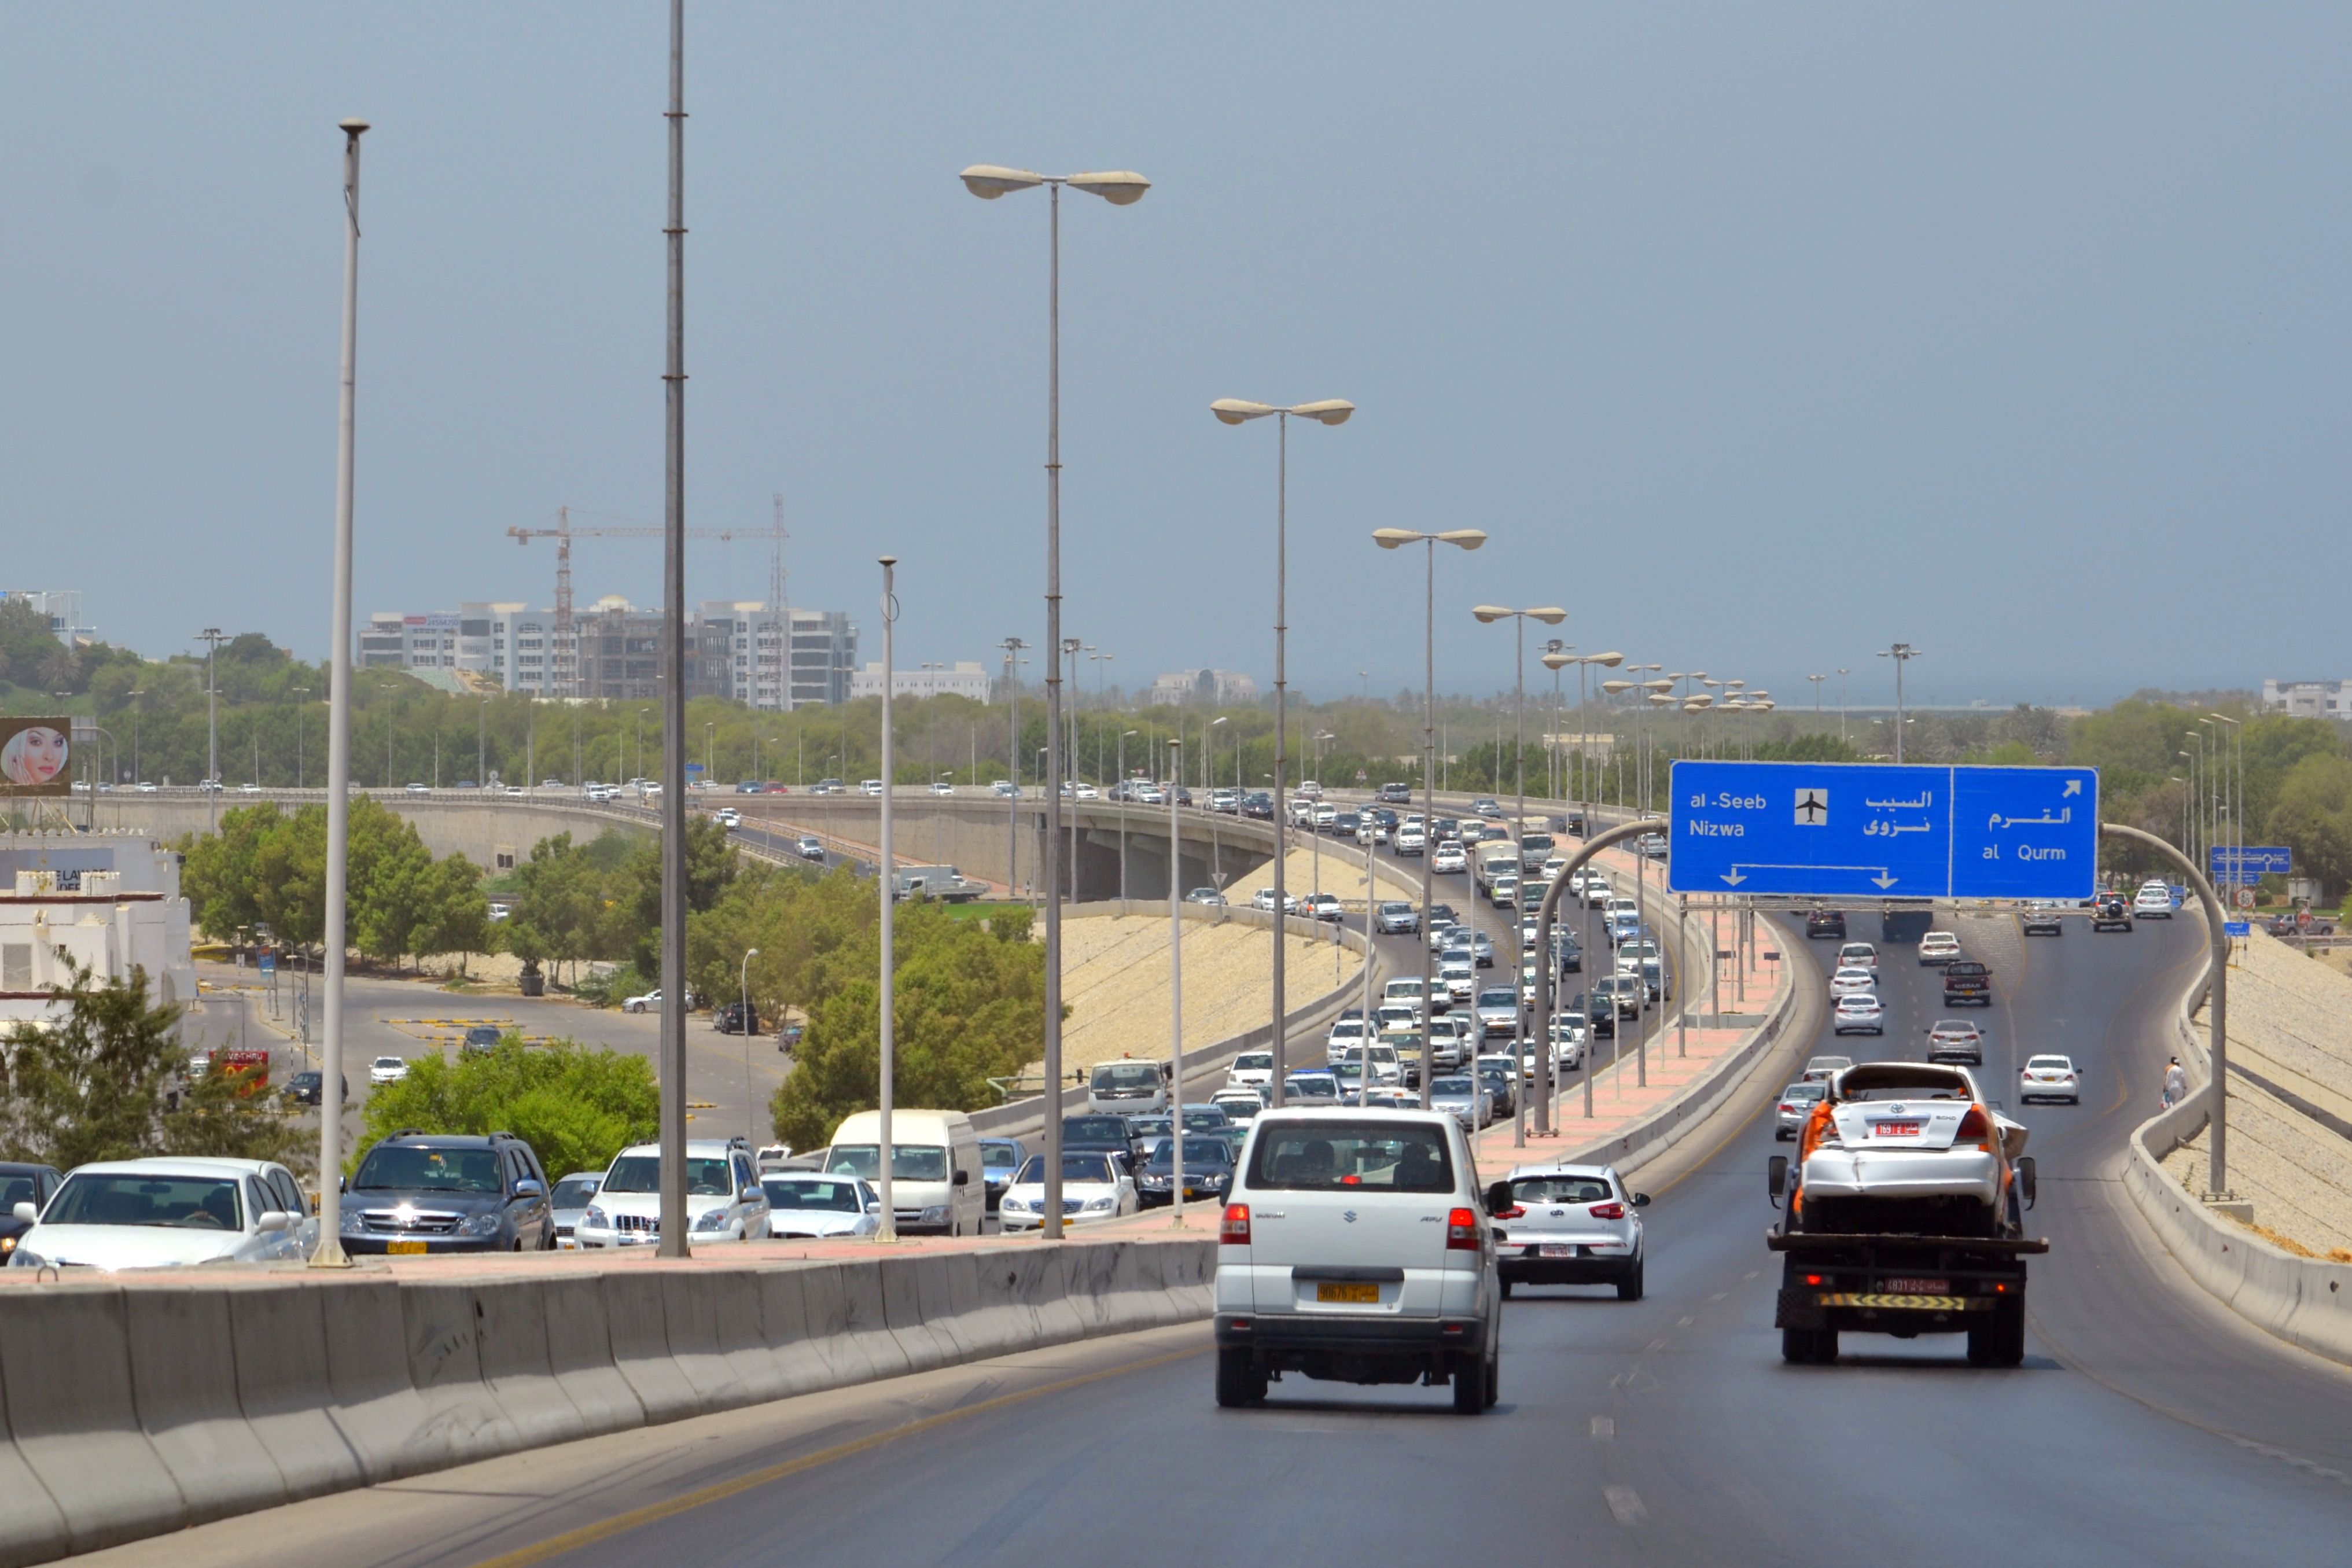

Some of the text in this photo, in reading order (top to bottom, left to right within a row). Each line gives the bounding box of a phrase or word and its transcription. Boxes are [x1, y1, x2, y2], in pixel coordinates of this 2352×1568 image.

[1690, 793, 1706, 808] al
[1865, 790, 1932, 812] السيب
[1690, 819, 1744, 837] Nizwa
[1988, 806, 2071, 833] القرم
[1982, 843, 2066, 862] al Qurm
[1879, 1124, 1891, 1133] 169
